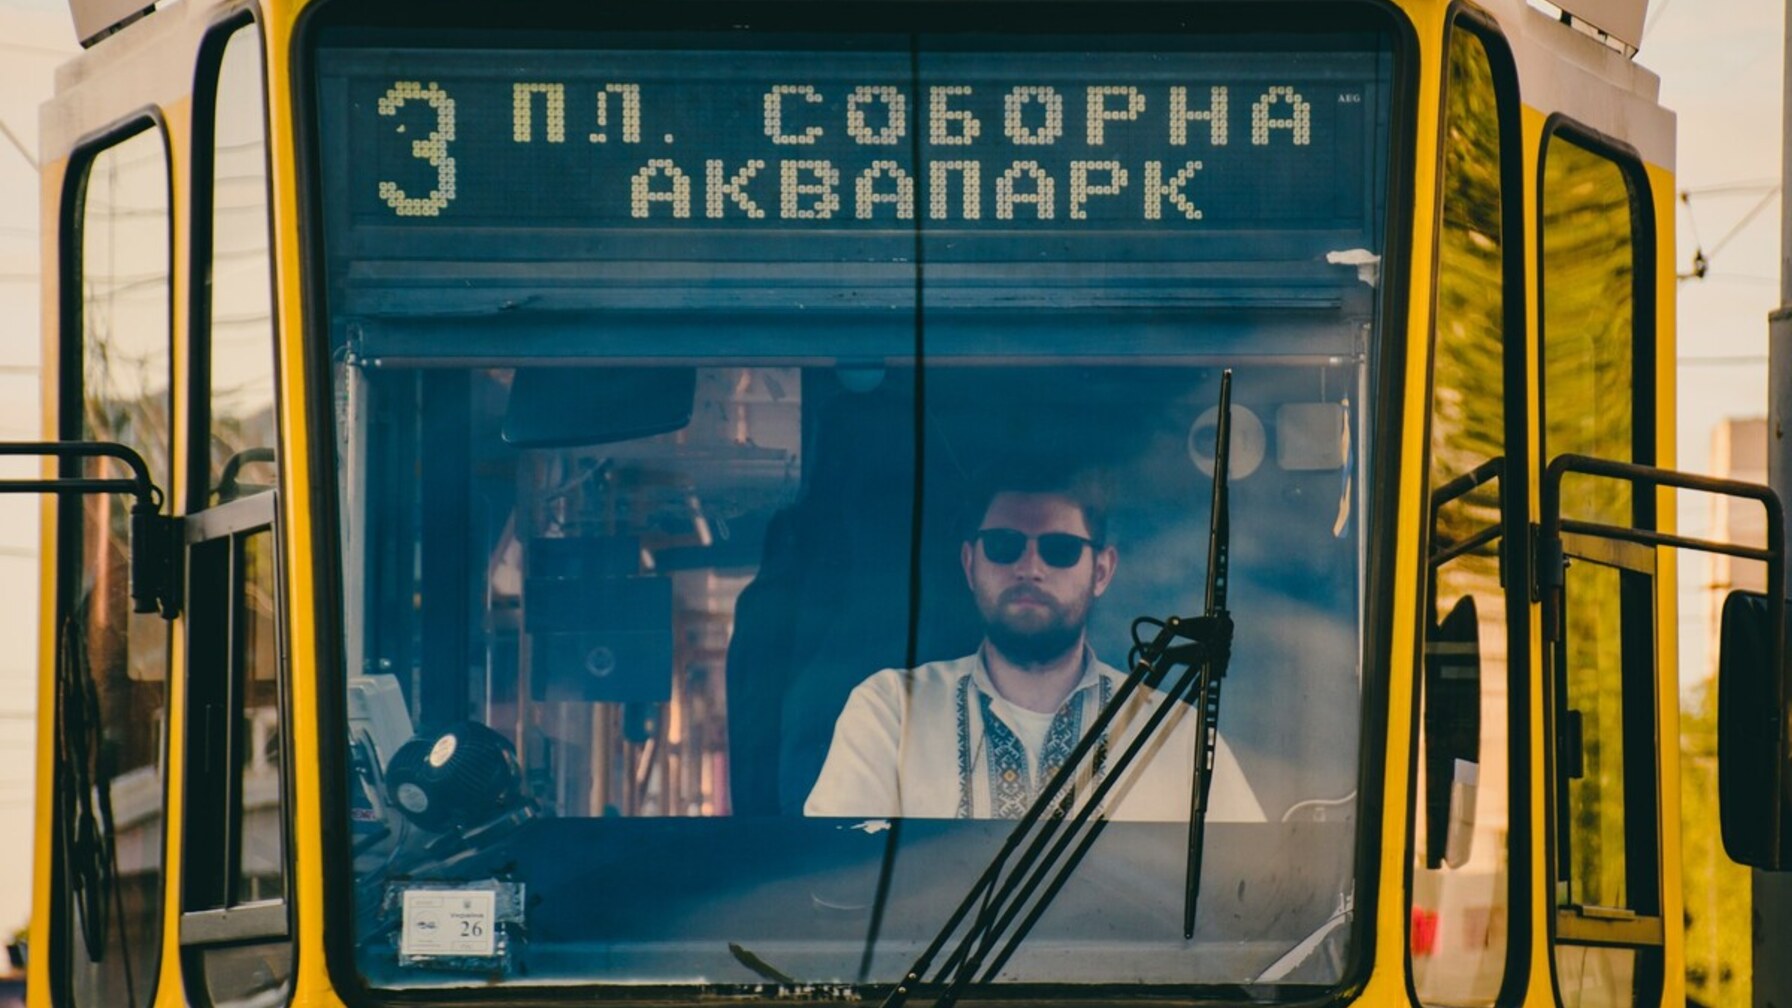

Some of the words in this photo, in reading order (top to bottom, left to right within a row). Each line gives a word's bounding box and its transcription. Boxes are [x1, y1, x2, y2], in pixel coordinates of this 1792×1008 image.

[513, 84, 673, 143] ПЛ.
[764, 86, 1311, 145] СОБОРНА
[379, 83, 456, 216] 3
[632, 160, 1203, 220] АКВАПАРК
[460, 920, 483, 937] 26
